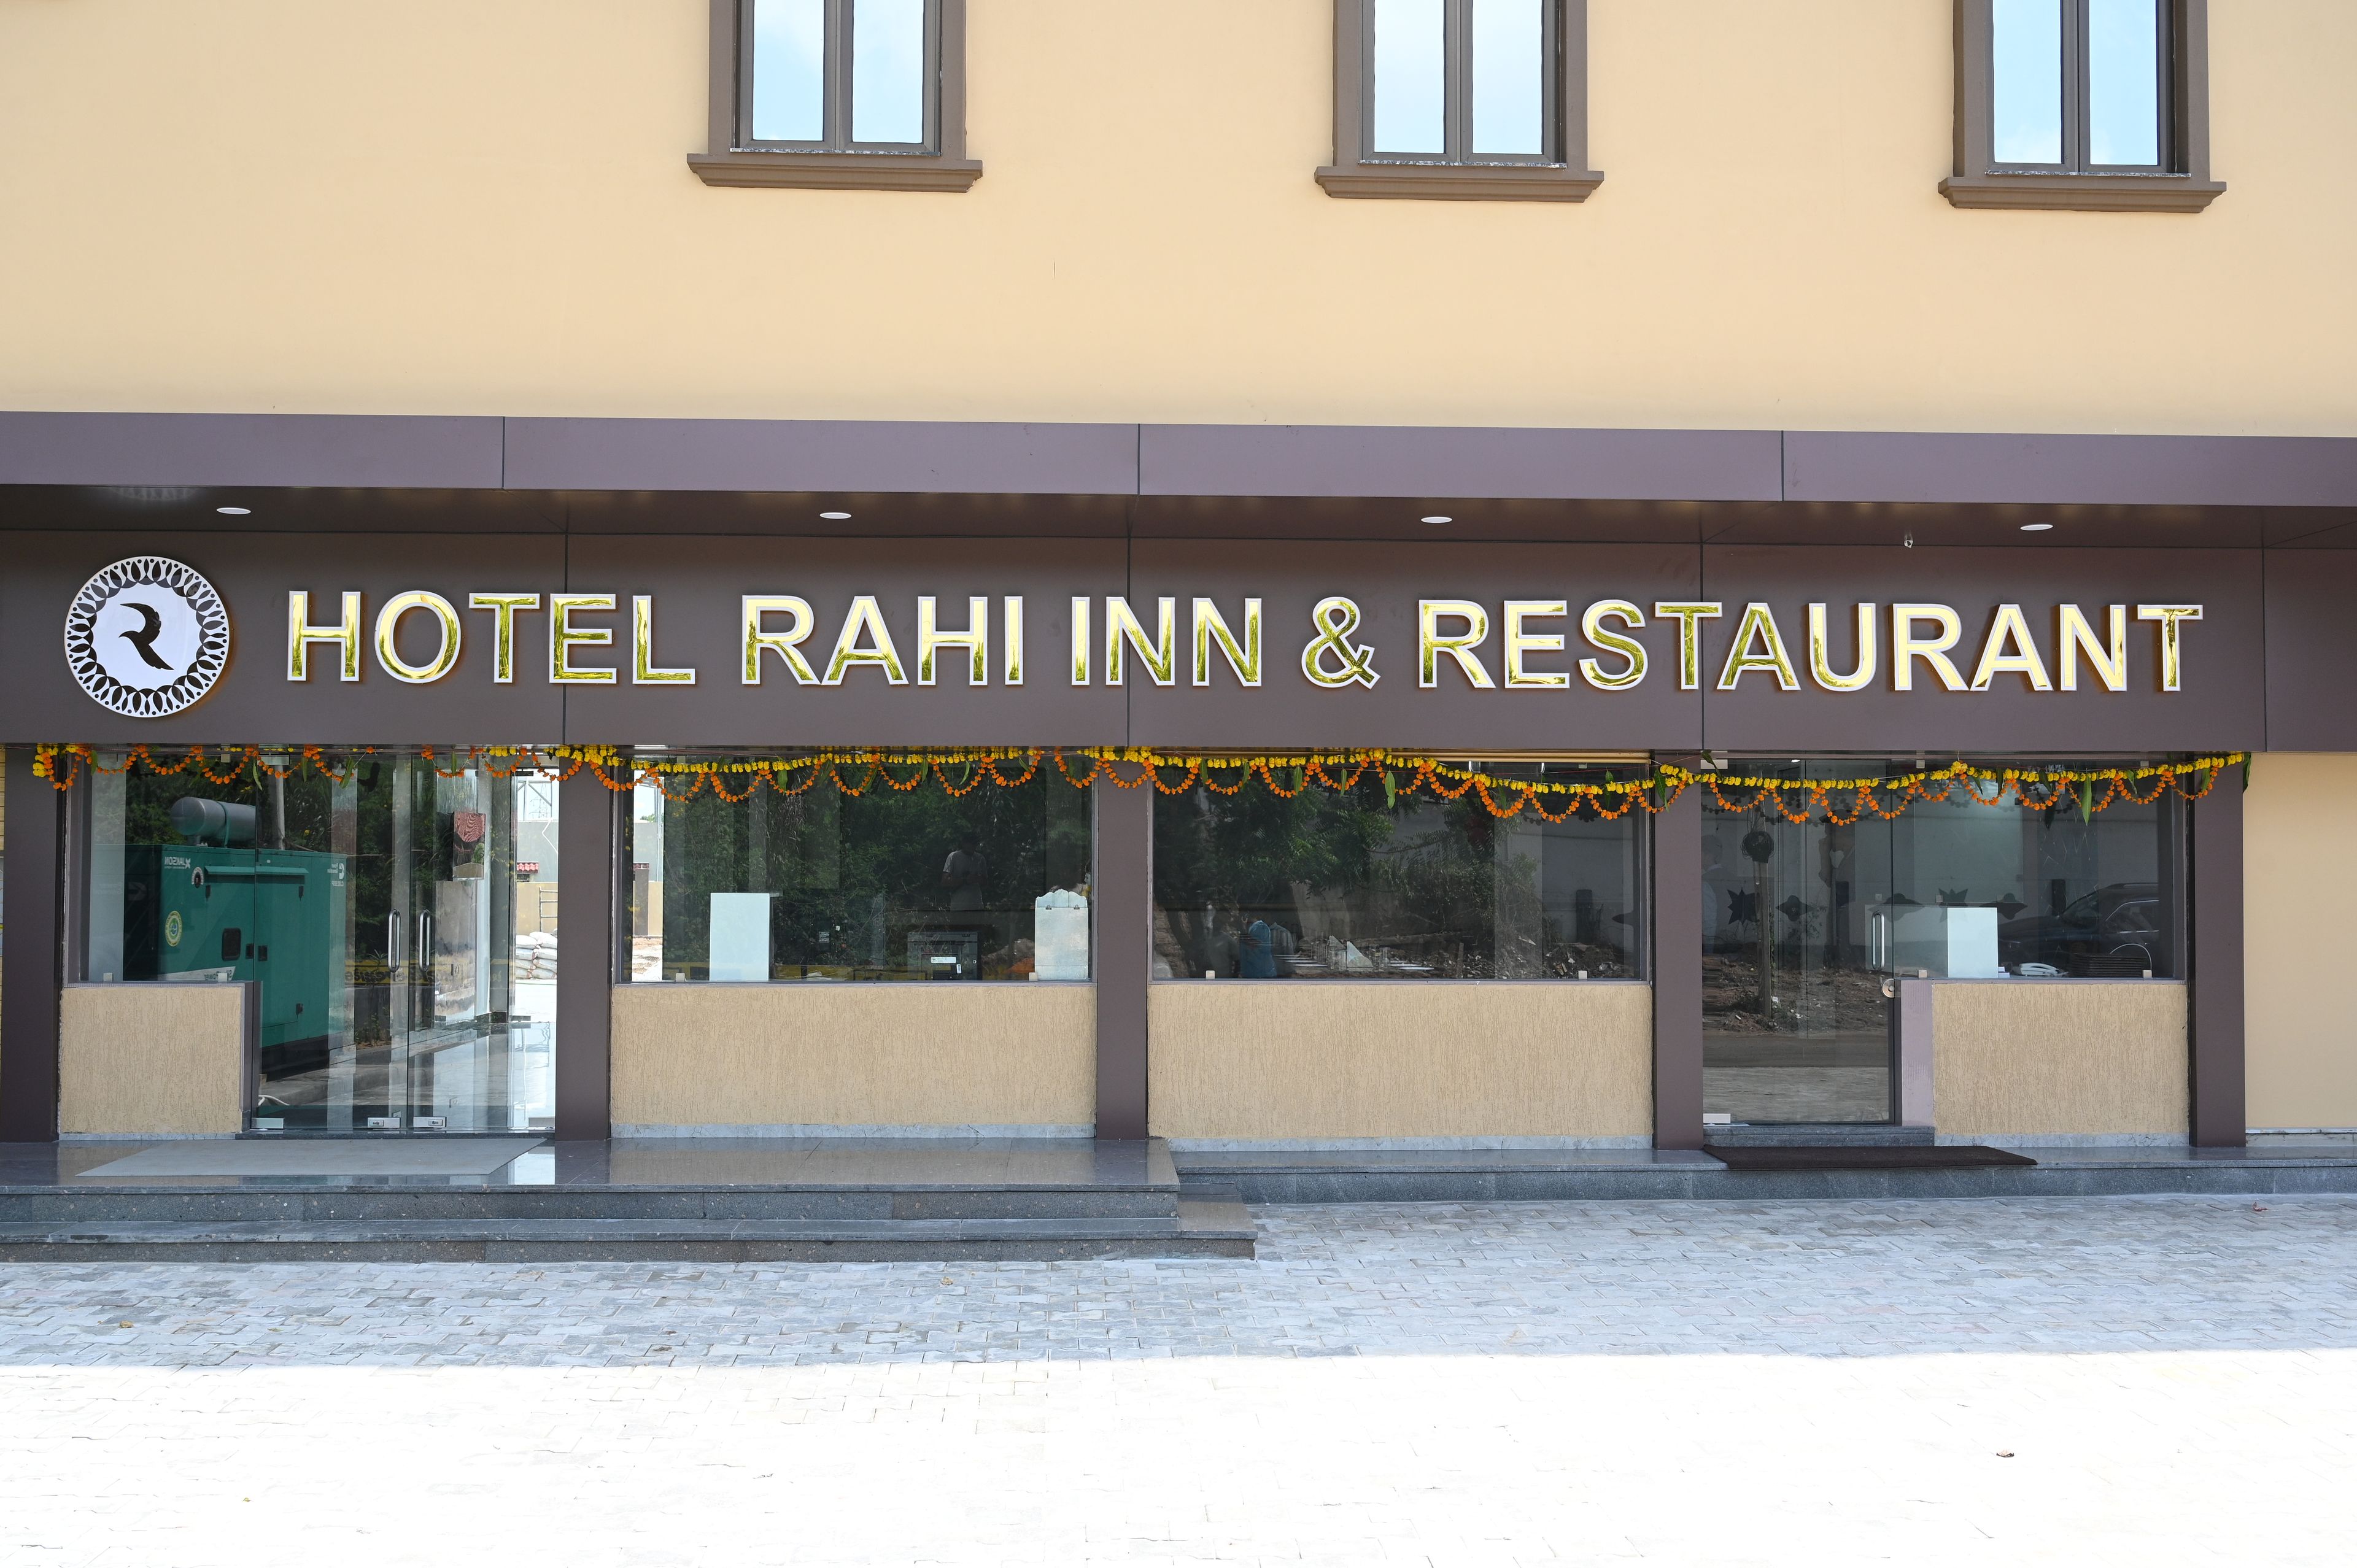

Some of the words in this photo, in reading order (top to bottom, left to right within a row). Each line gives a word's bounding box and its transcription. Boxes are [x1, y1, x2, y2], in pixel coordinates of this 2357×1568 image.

[287, 590, 695, 684] HOTEL
[741, 595, 1024, 687] RAHI
[1071, 597, 1262, 687] INN
[1301, 596, 1381, 690] &
[1418, 600, 2204, 692] RESTAURANT
